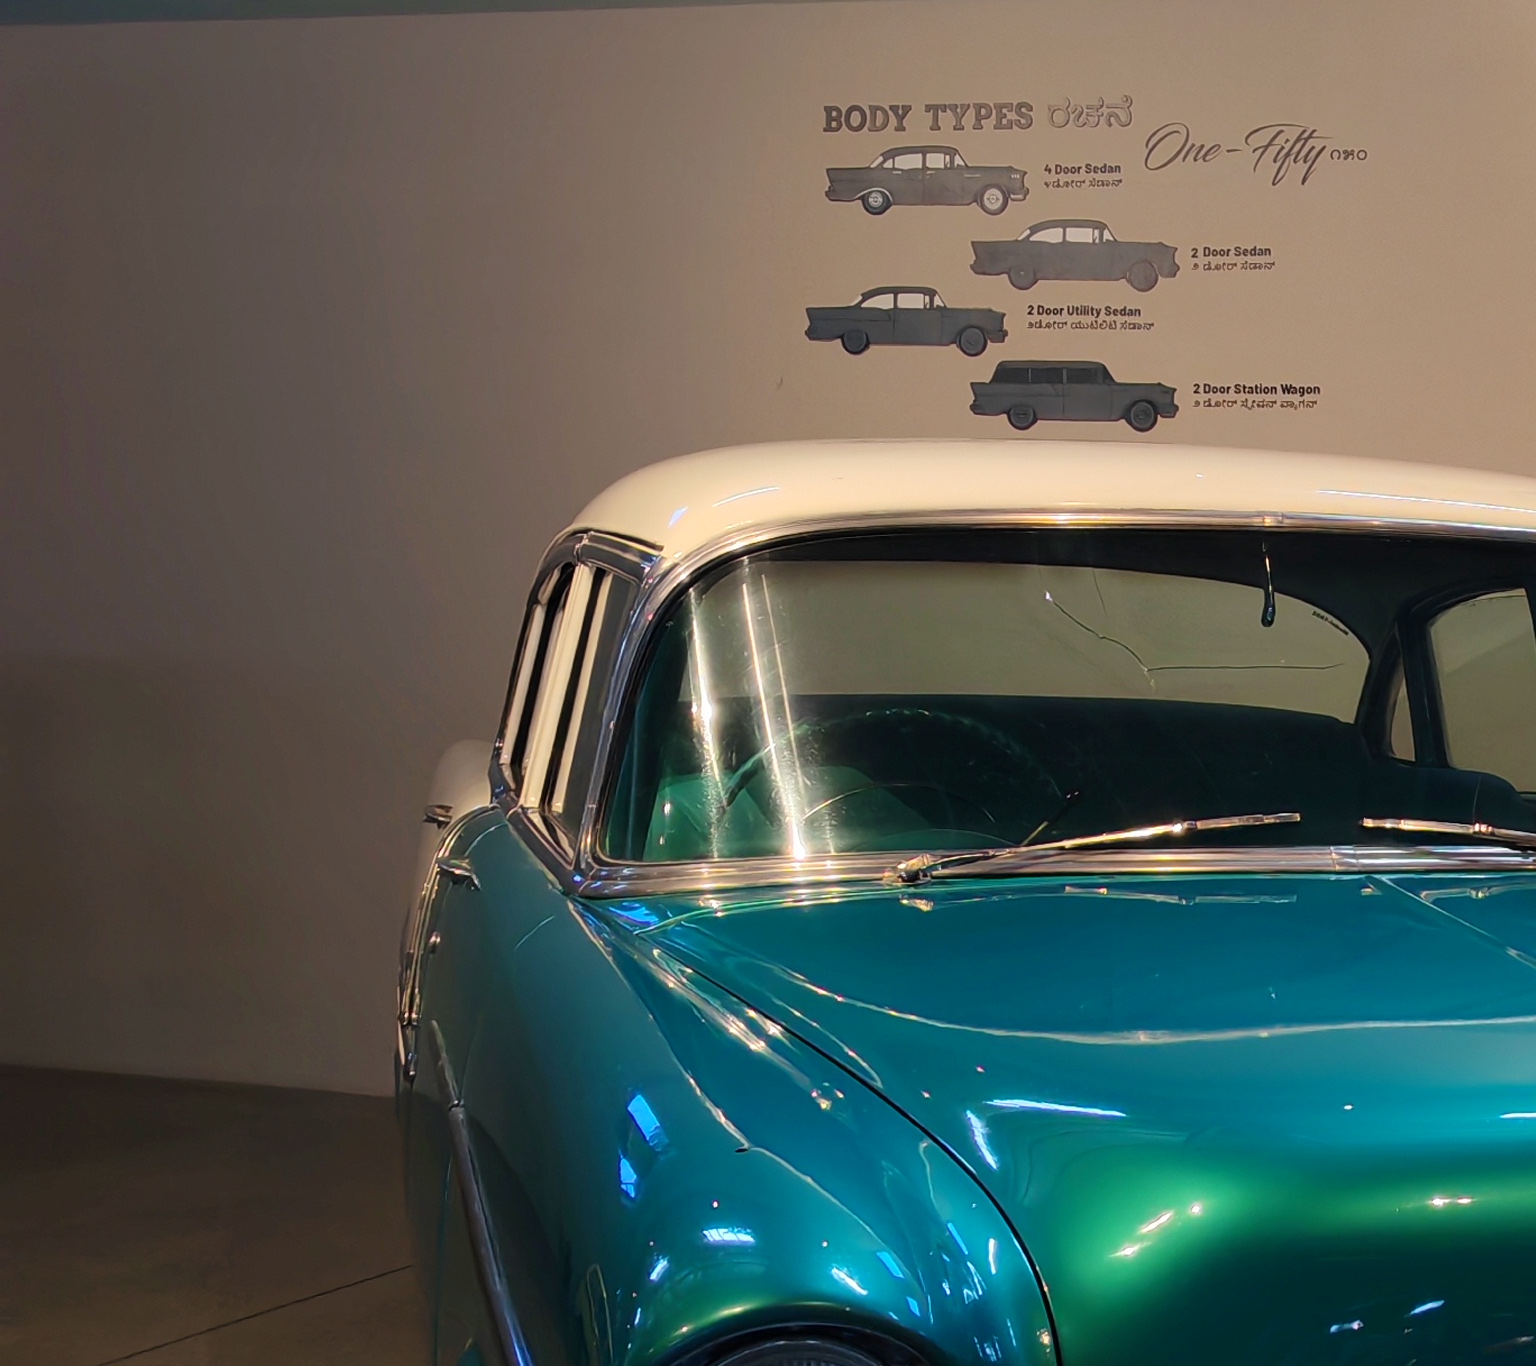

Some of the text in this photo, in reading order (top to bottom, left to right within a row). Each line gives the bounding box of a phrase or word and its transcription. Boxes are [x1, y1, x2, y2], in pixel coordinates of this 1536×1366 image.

[823, 95, 1134, 133] BODY TYPES ರಚನೆ
[1043, 162, 1122, 176] 4 Door Sedan
[1190, 245, 1272, 259] 2 Door Sedan
[1026, 304, 1142, 319] 2 Door Utility Sedan
[1192, 382, 1321, 398] 2 Door Station Wagon
